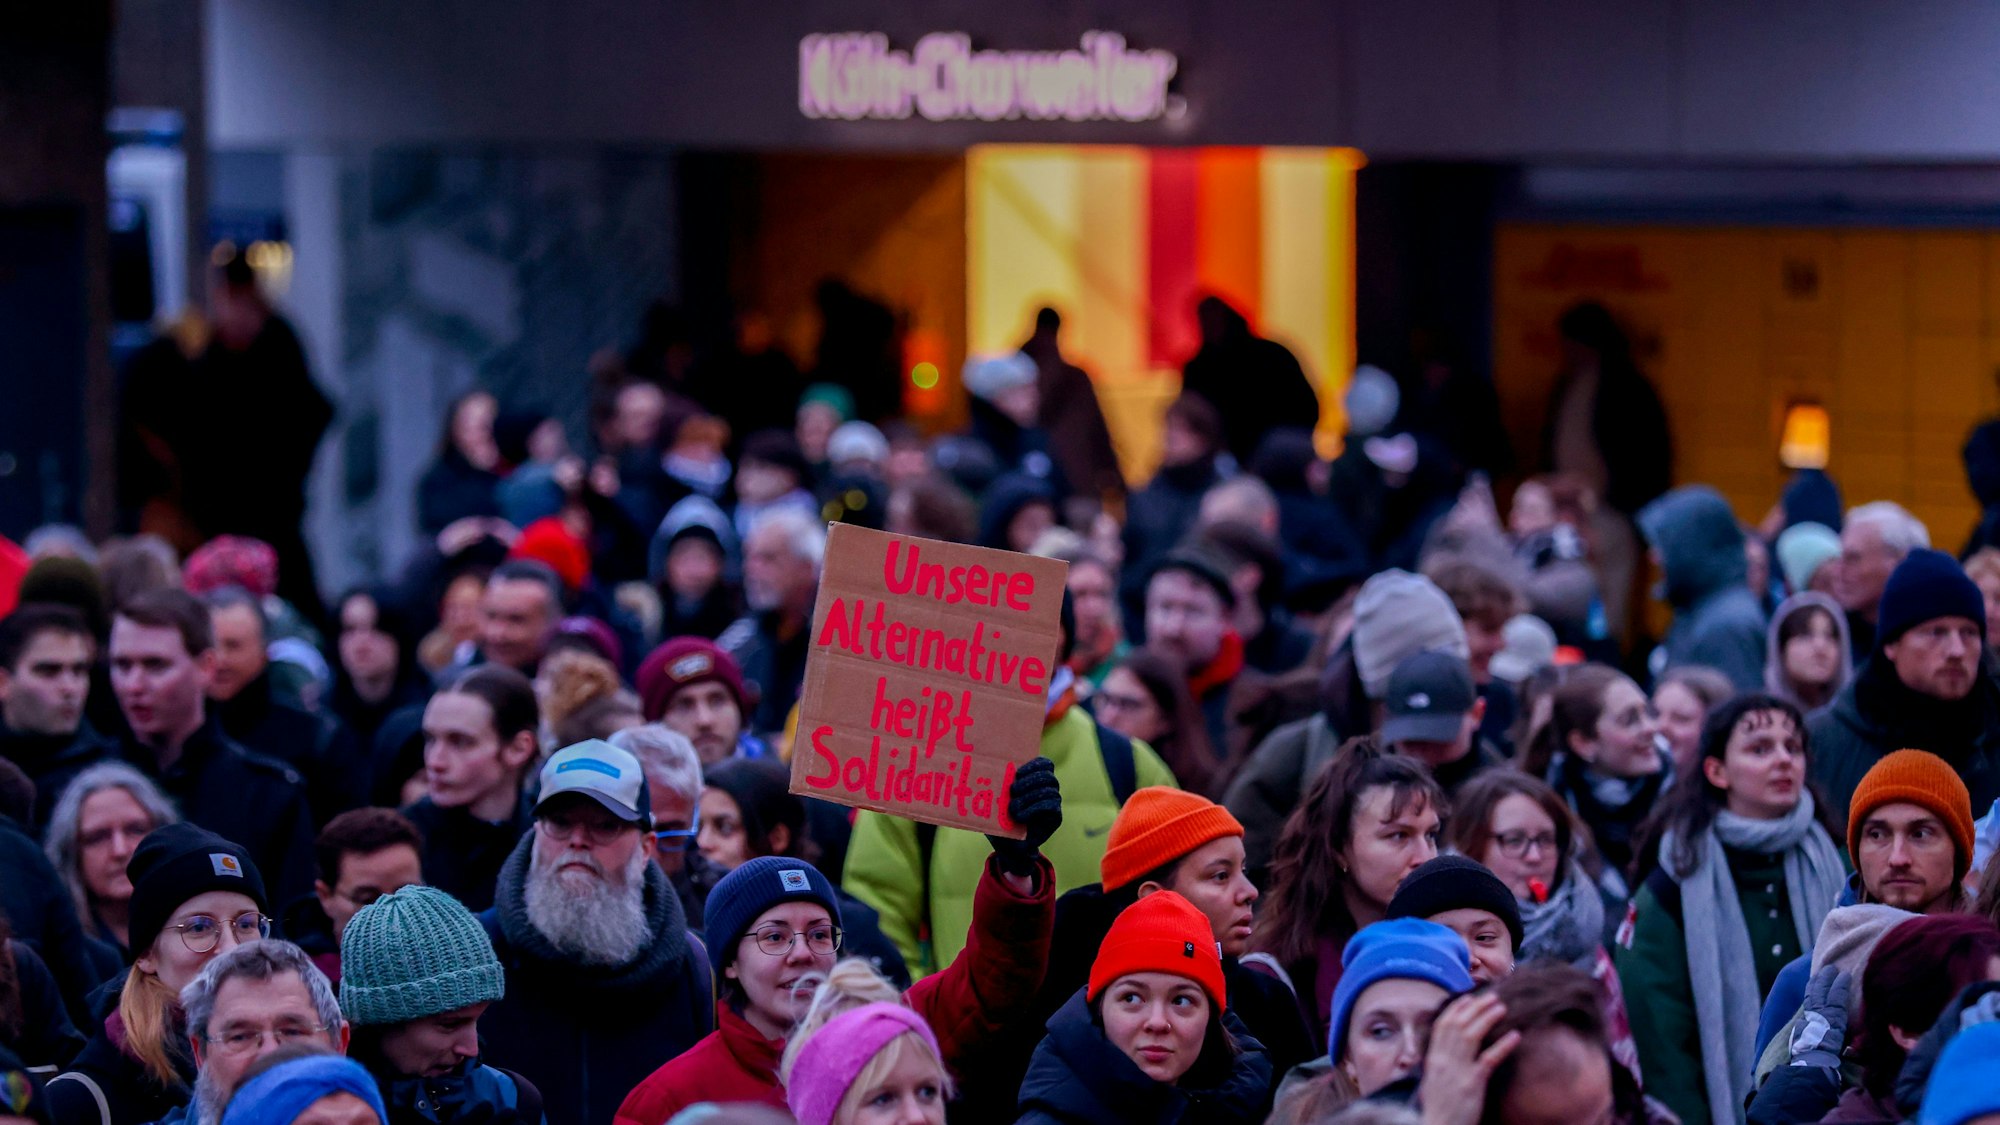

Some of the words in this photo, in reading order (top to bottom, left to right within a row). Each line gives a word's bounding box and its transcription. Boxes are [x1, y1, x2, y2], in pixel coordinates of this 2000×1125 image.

[883, 539, 1036, 613] Unsere
[817, 596, 1047, 696] Alternative
[869, 675, 975, 760] heißt
[804, 724, 1017, 832] Solidarität
